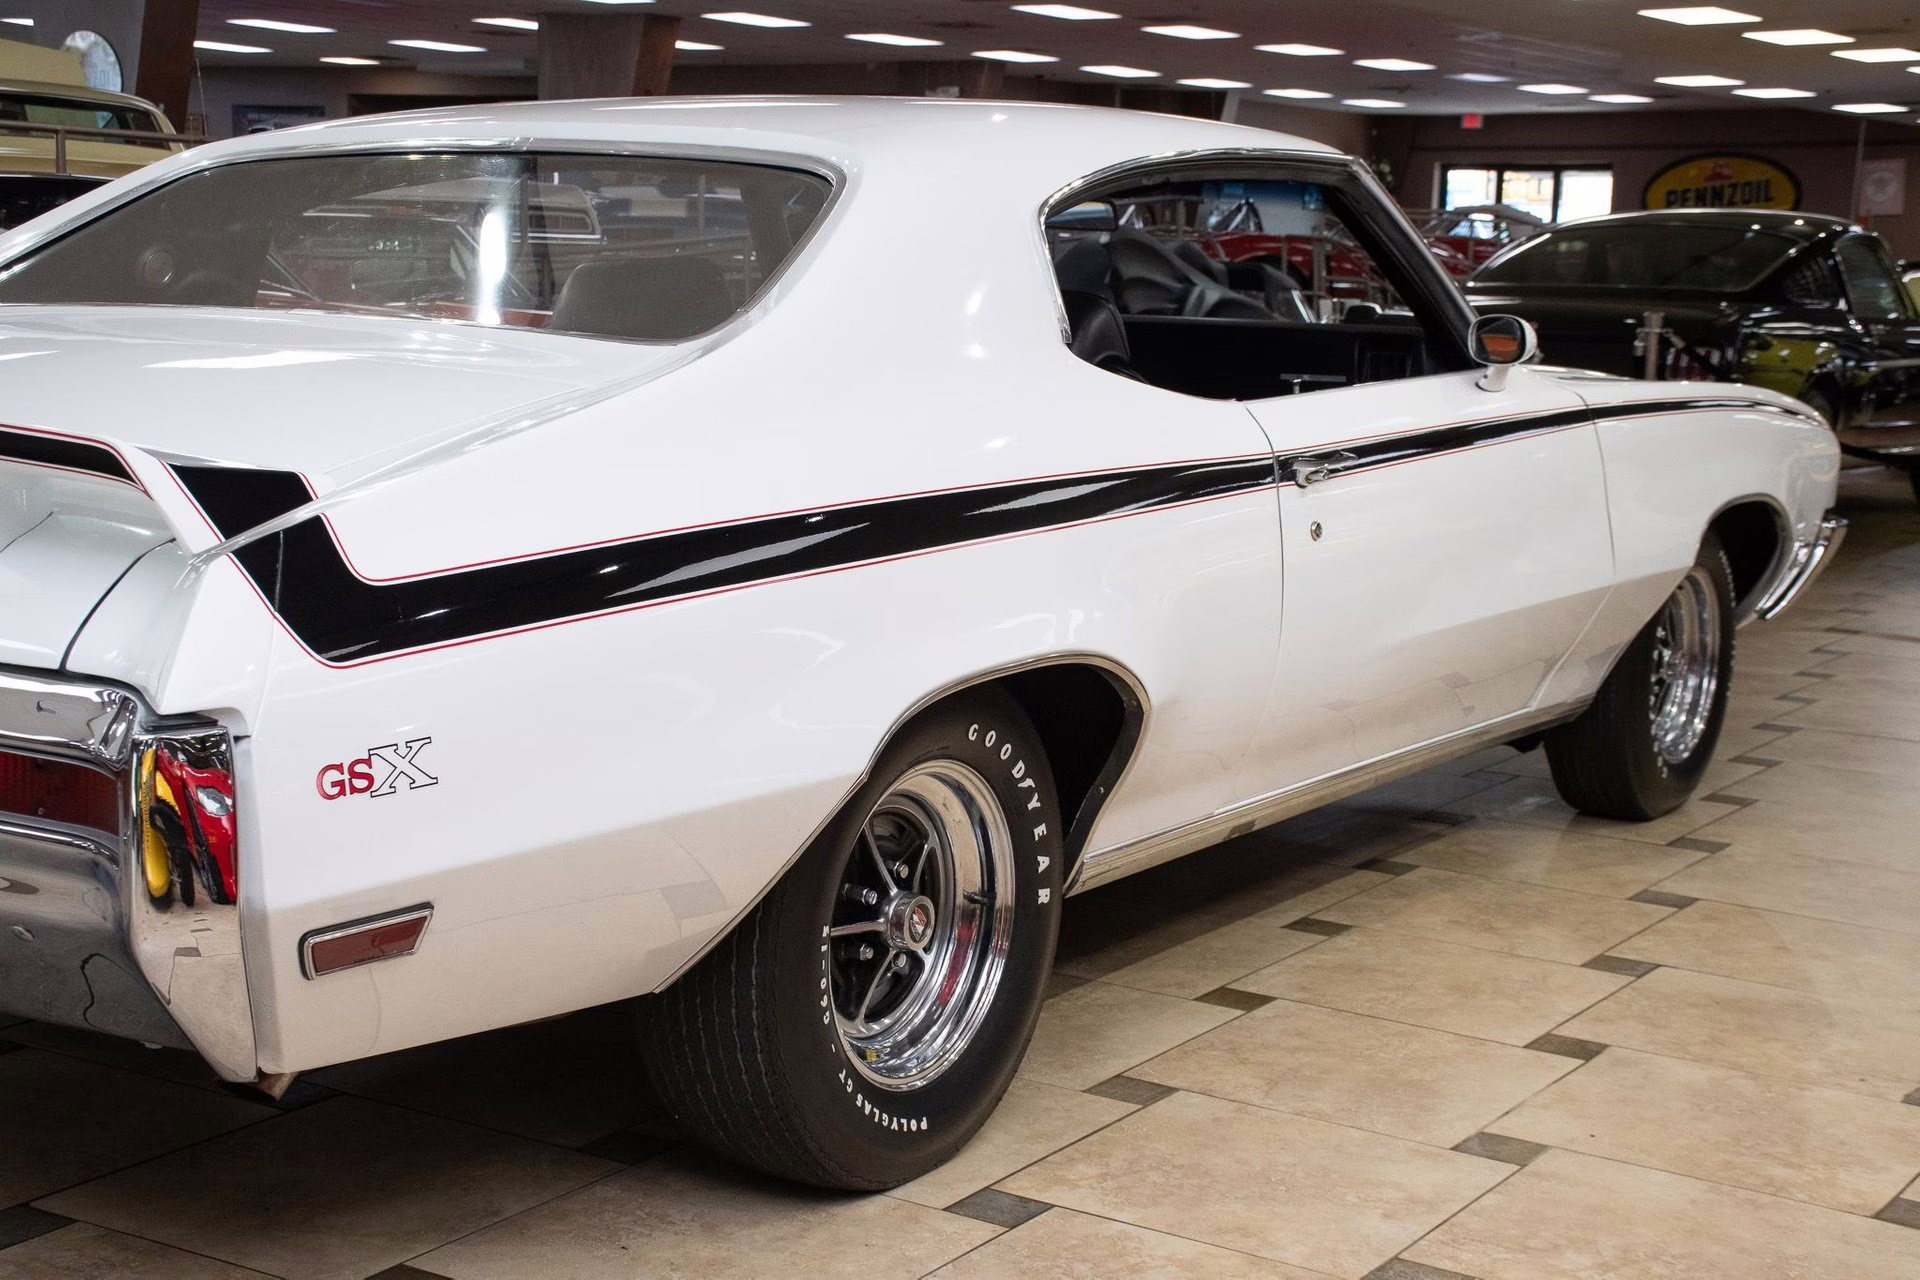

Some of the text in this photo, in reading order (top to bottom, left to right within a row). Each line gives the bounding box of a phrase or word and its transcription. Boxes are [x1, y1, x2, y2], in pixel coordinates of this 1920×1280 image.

[1666, 179, 1773, 208] PENNZOIL
[316, 736, 438, 800] GSX
[968, 723, 1051, 906] GOODYEAR
[838, 1068, 853, 1093] GT
[856, 1093, 928, 1131] POLYGLAS
